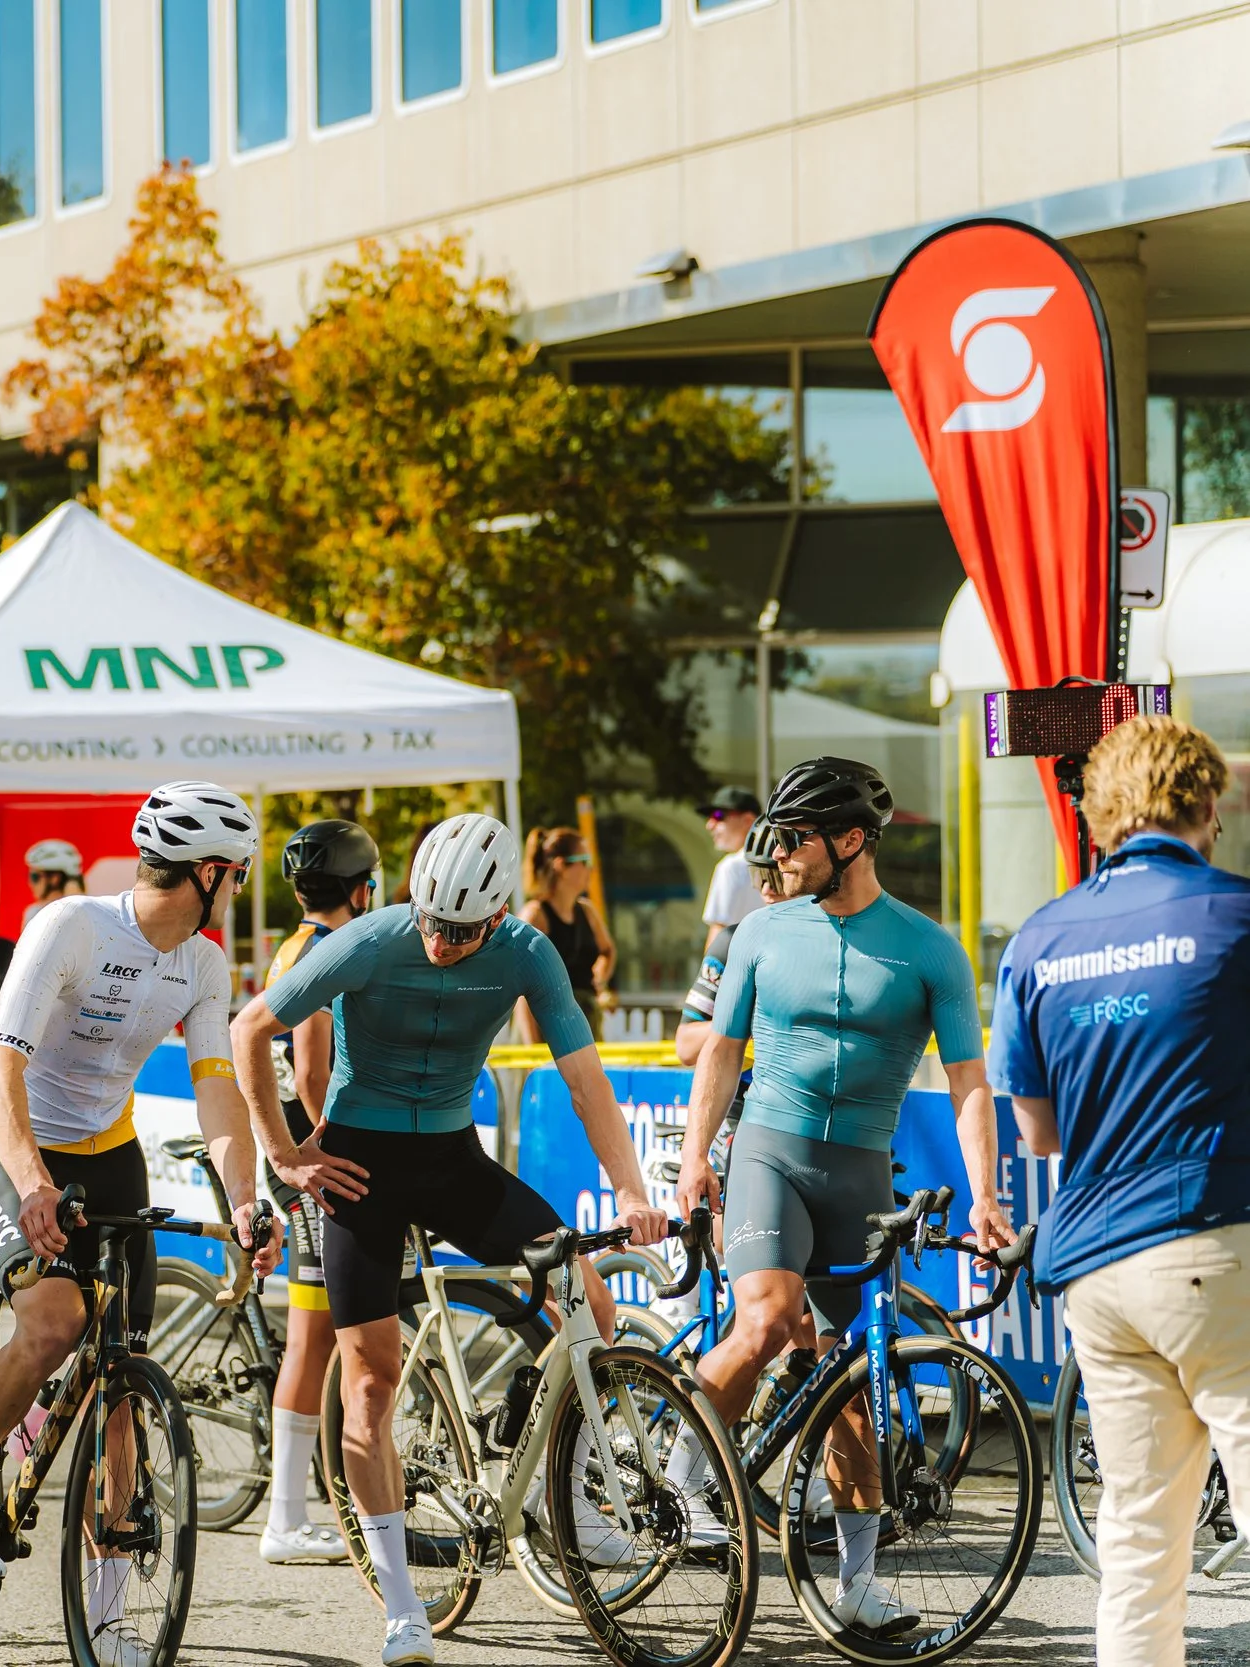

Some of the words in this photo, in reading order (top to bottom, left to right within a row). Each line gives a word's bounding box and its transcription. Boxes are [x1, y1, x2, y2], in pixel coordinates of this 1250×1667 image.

[24, 644, 285, 690] MNP
[181, 732, 347, 758] CONSULTING
[392, 729, 436, 751] TAX
[989, 700, 998, 739] LYNX
[101, 962, 143, 979] LRCC
[1033, 933, 1197, 990] Commissaire
[749, 1331, 854, 1465] MAGNAN
[871, 1349, 886, 1443] MAGNAN
[506, 1379, 550, 1488] MAGNAN
[589, 1418, 609, 1474] MAGNAN
